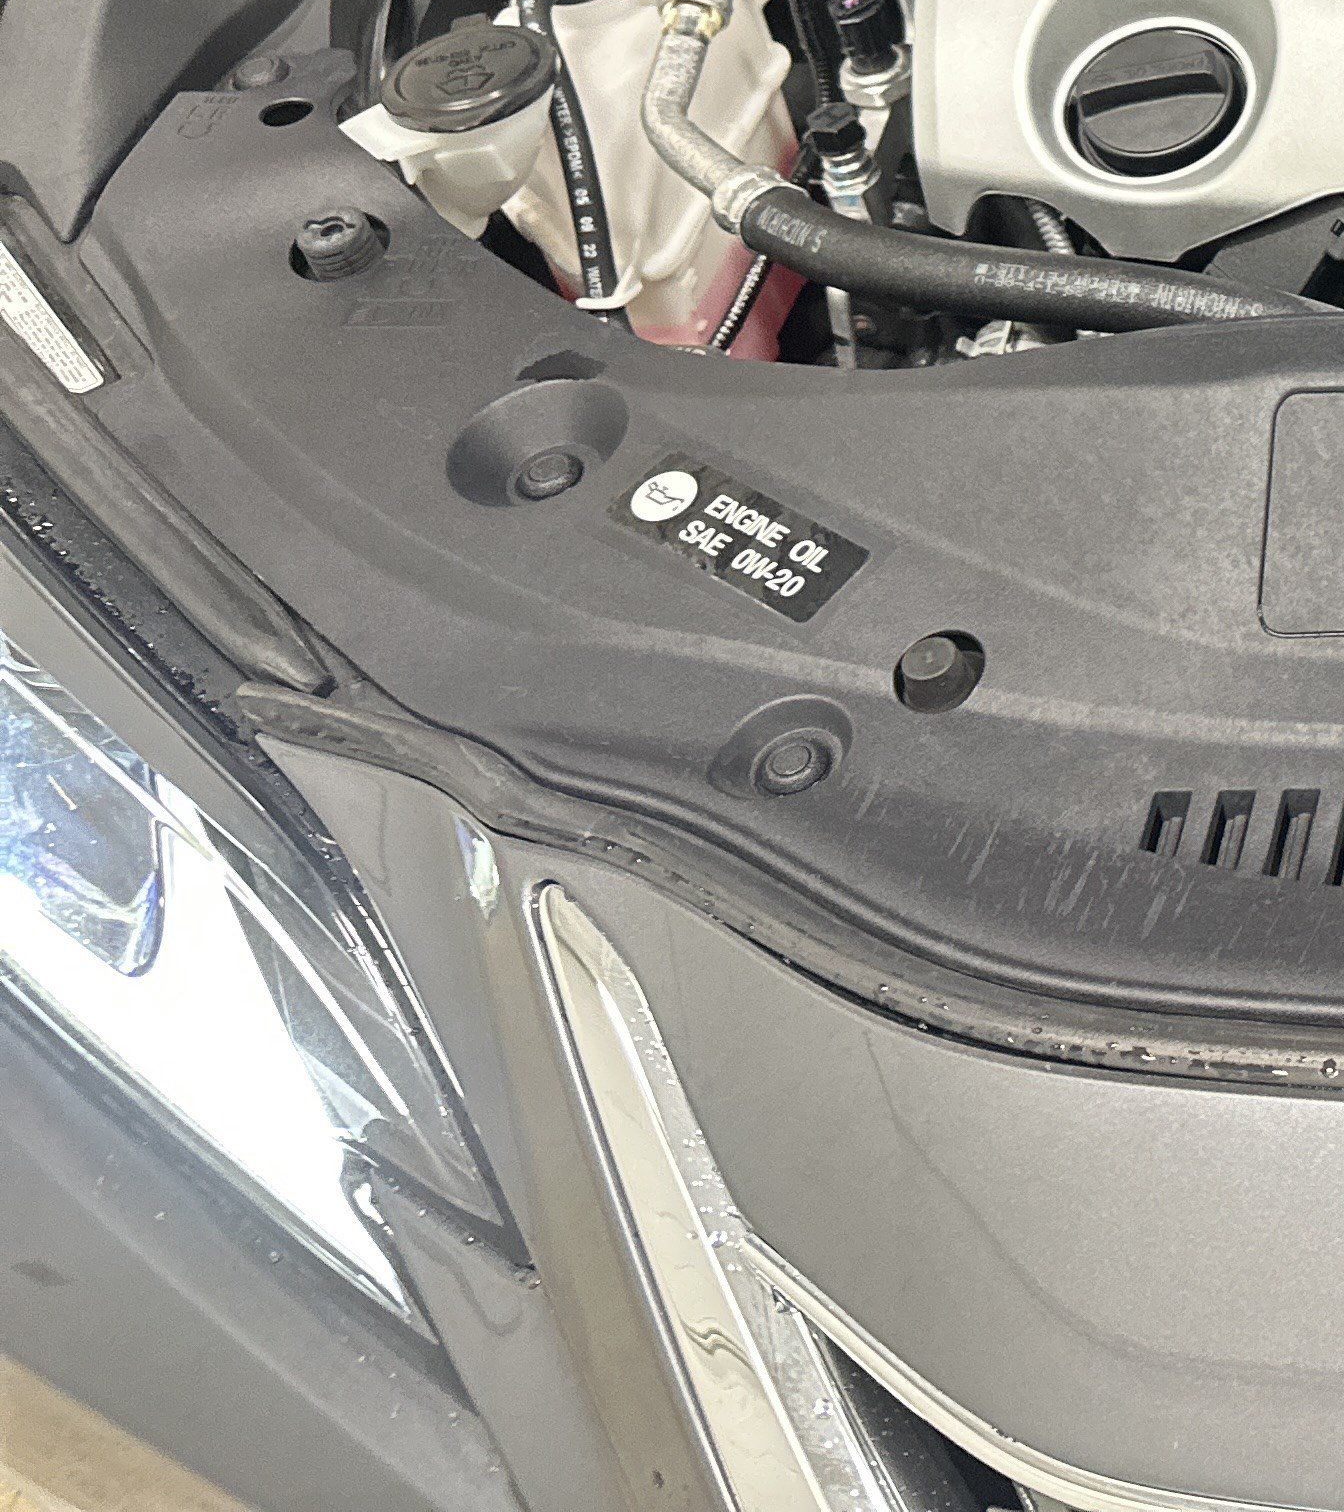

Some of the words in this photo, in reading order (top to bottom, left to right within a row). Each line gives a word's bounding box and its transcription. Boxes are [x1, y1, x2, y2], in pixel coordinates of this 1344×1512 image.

[586, 266, 603, 299] WATE
[679, 520, 733, 557] SAE
[731, 548, 806, 597] 0W-20
[704, 494, 791, 548] ENGINE
[788, 539, 829, 573] OIL
